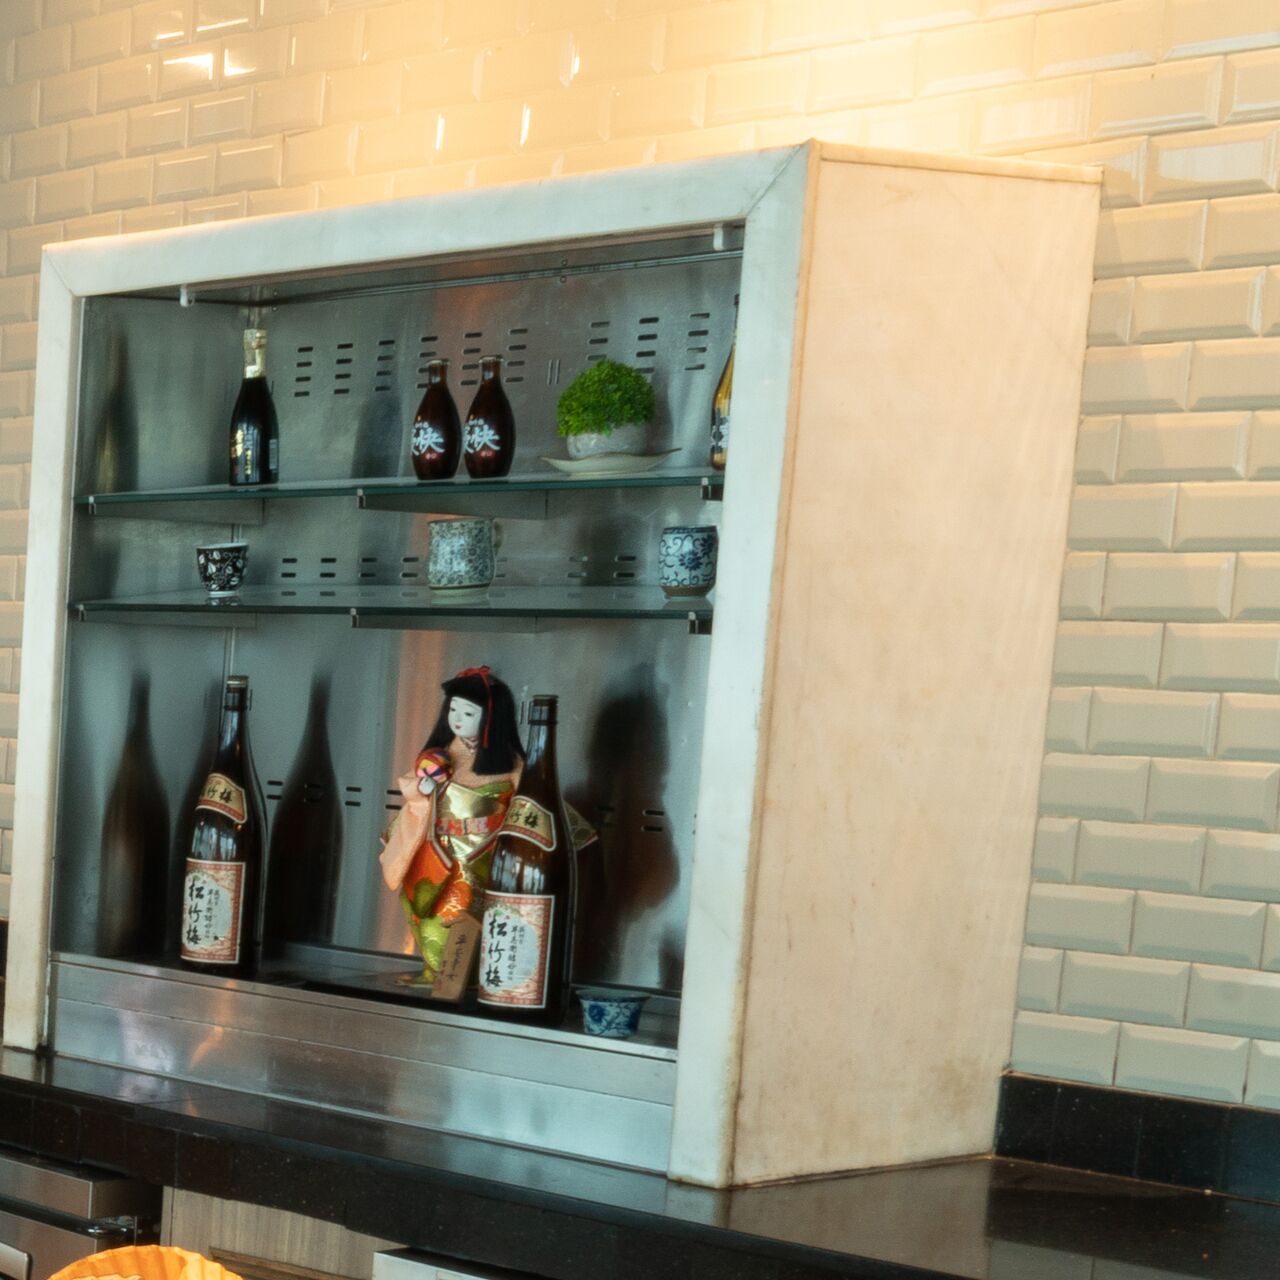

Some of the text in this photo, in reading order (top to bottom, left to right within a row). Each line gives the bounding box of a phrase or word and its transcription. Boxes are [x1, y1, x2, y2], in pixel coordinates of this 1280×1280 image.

[186, 881, 204, 945] 松竹梅
[485, 913, 507, 987] 松竹梅
